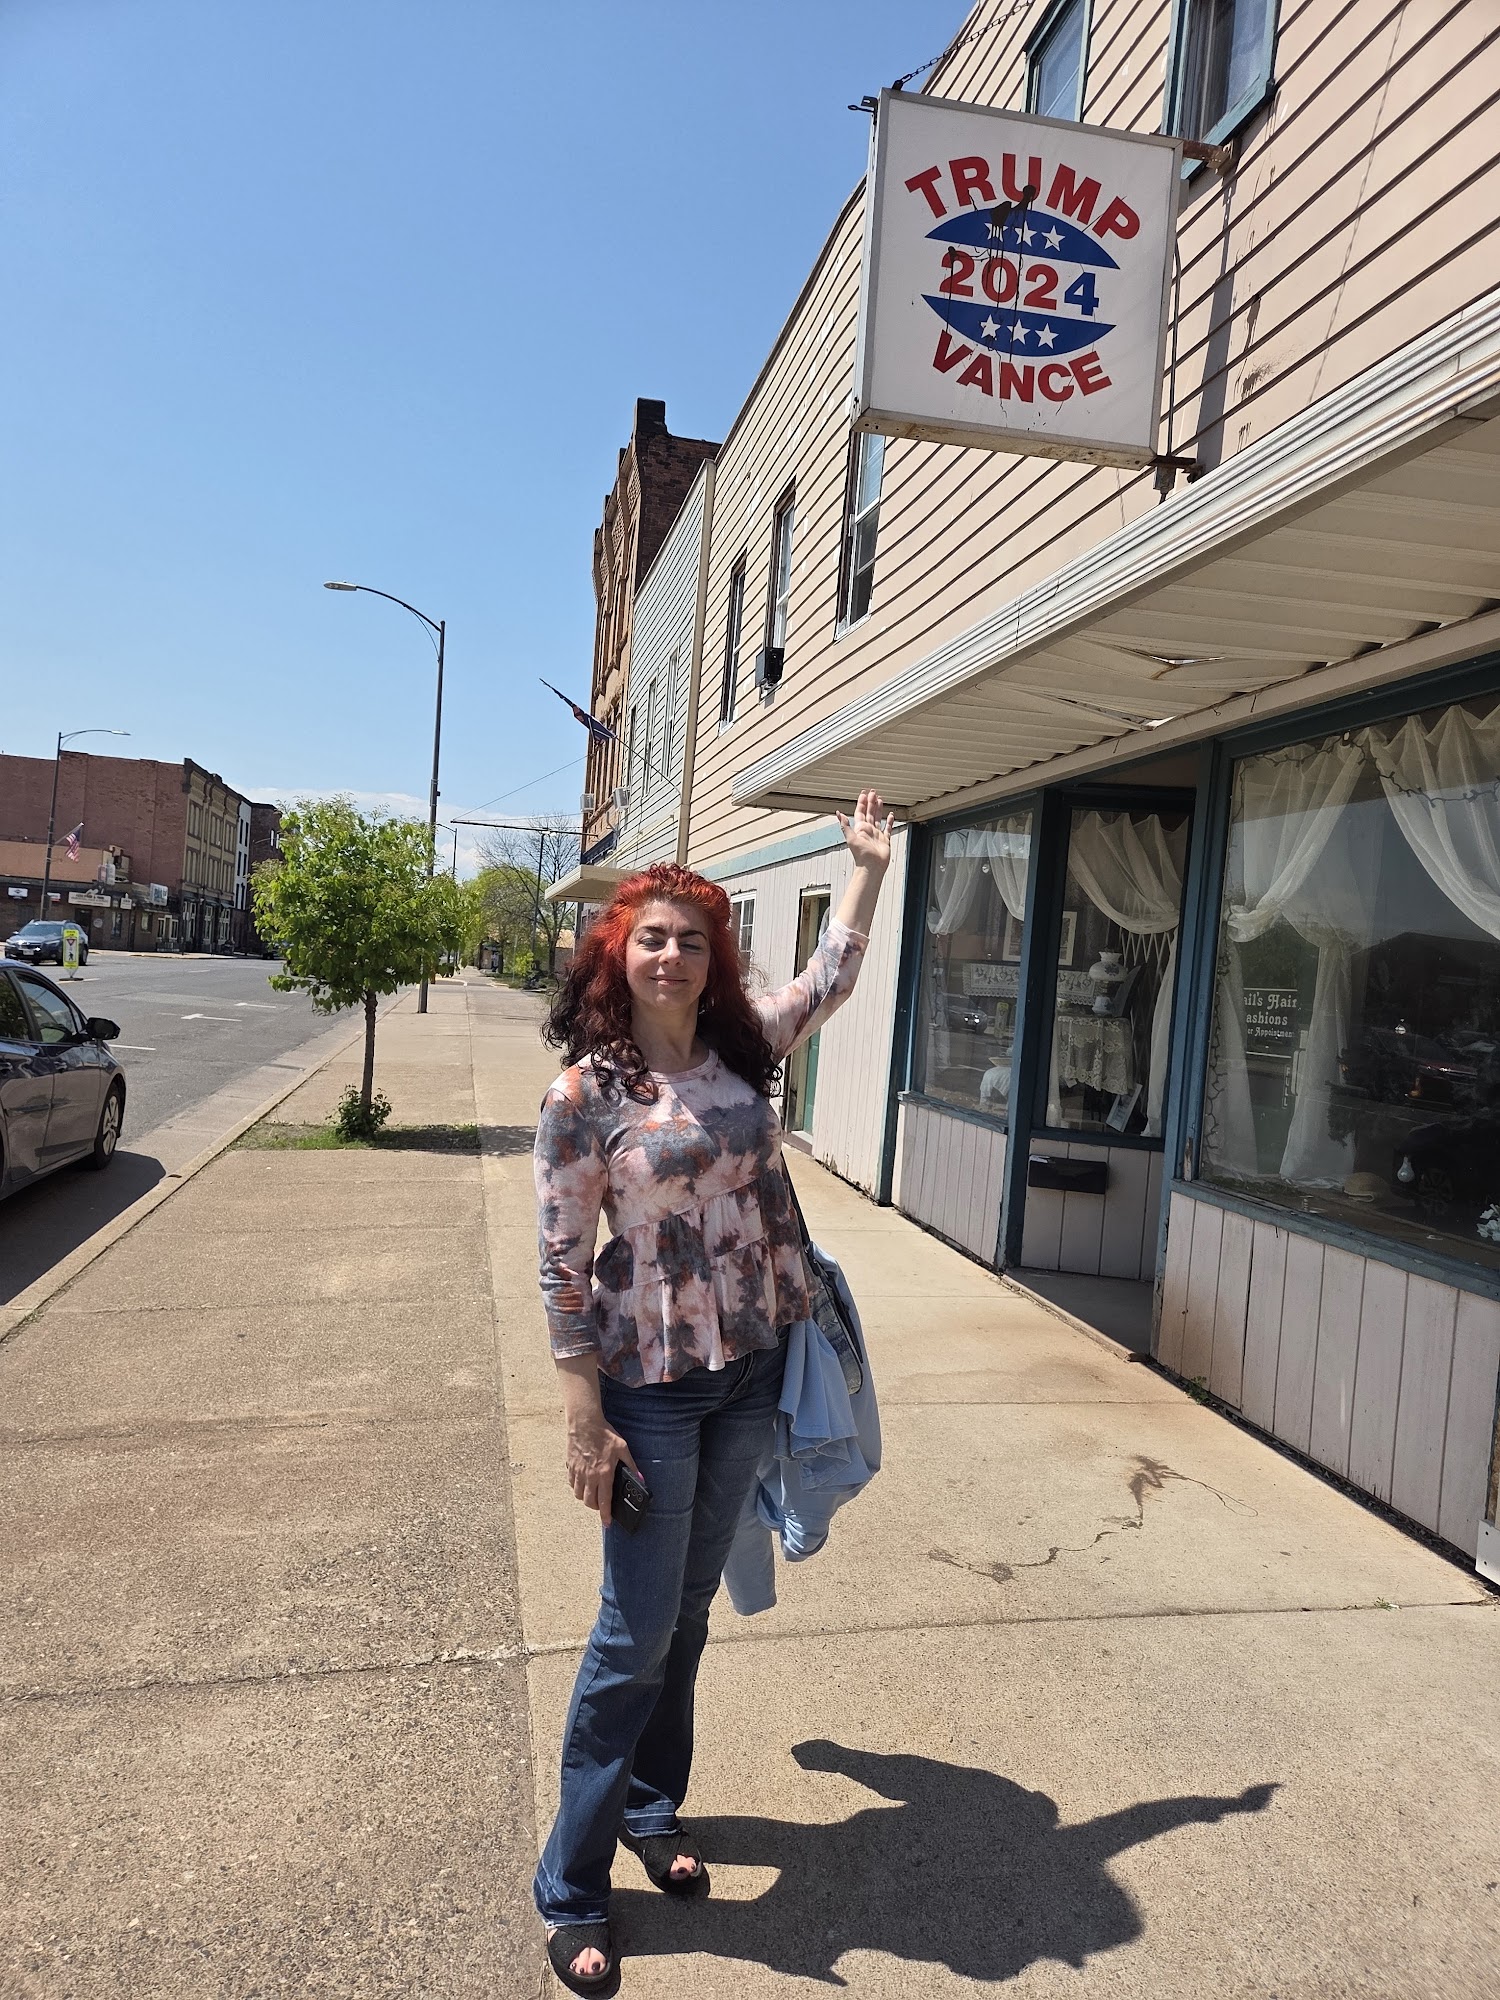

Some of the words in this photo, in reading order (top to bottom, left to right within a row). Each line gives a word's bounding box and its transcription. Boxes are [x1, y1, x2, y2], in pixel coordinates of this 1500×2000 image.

[905, 153, 1140, 240] TRUMP
[939, 250, 1099, 316] 2024
[933, 330, 1112, 403] VANCE
[1246, 1010, 1288, 1026] ashions
[1266, 993, 1298, 1010] Hair
